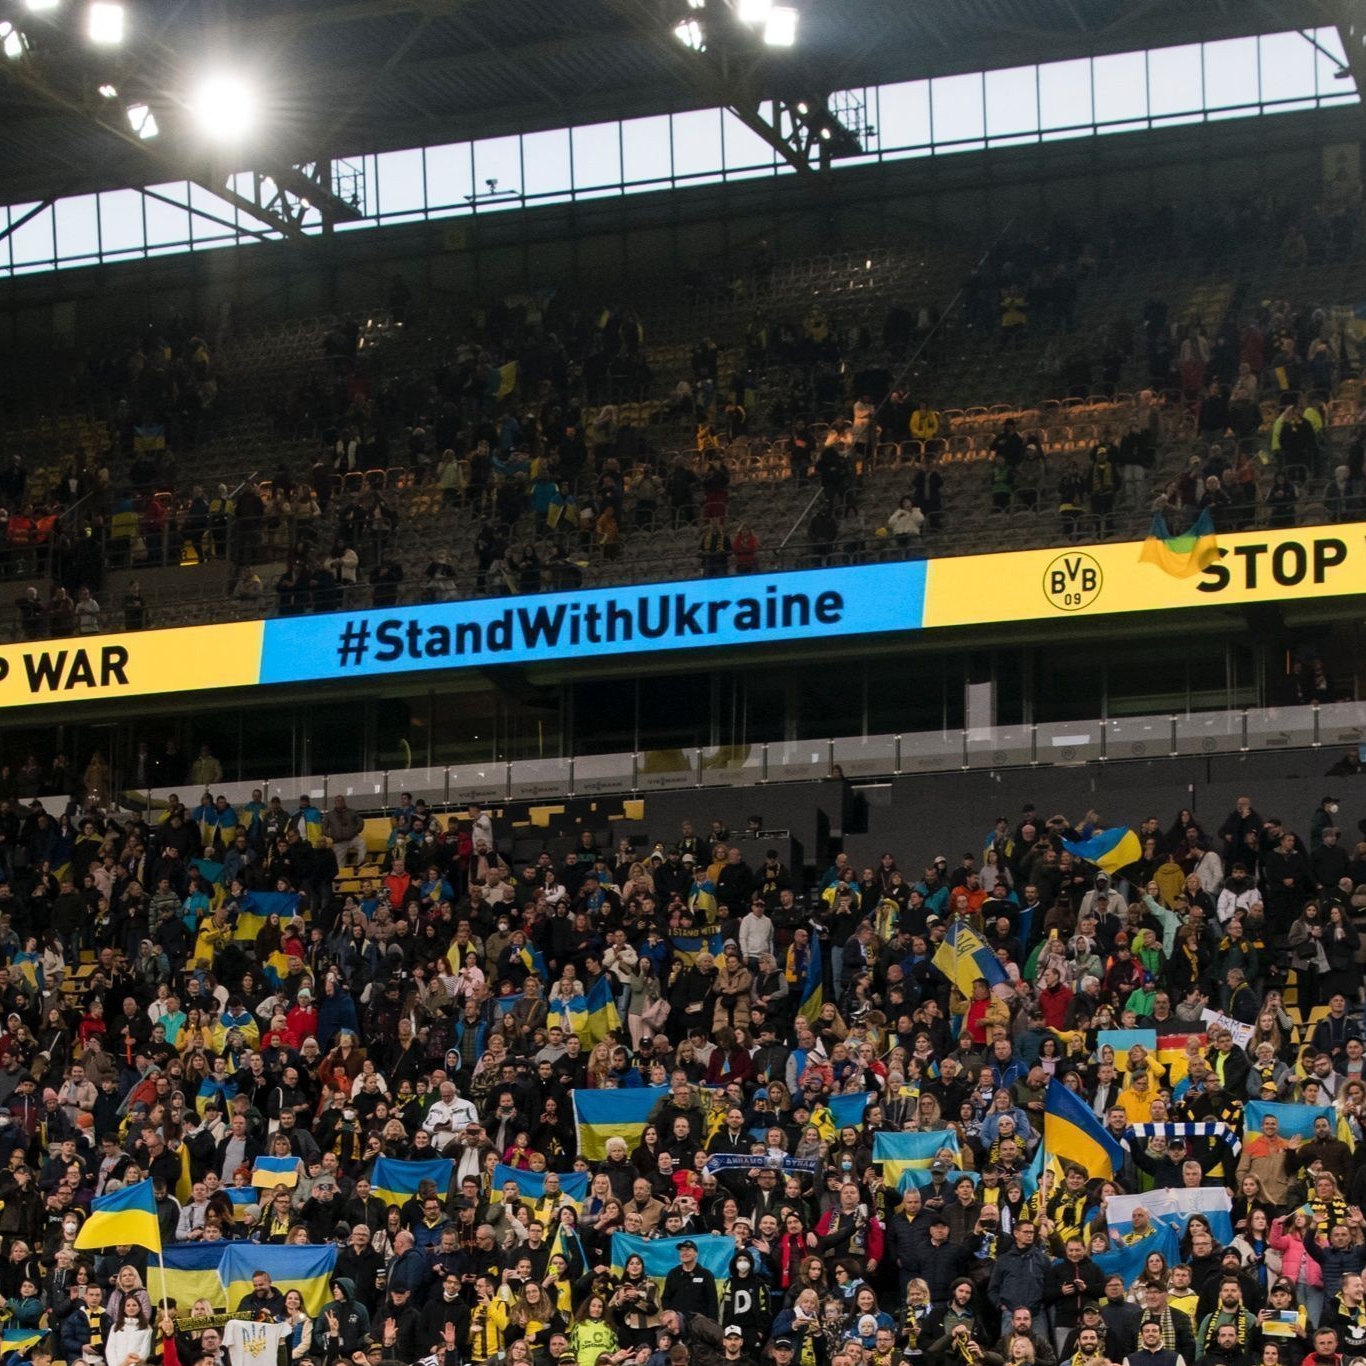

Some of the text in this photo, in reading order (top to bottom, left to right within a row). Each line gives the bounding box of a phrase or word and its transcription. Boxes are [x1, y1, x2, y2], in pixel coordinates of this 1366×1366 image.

[1052, 558, 1096, 594] BVB
[1197, 539, 1346, 592] STOP
[1065, 594, 1081, 606] 09
[338, 590, 843, 666] #StandWithUkraine
[24, 646, 128, 692] WAR
[673, 927, 699, 937] STAND
[734, 1289, 752, 1315] D
